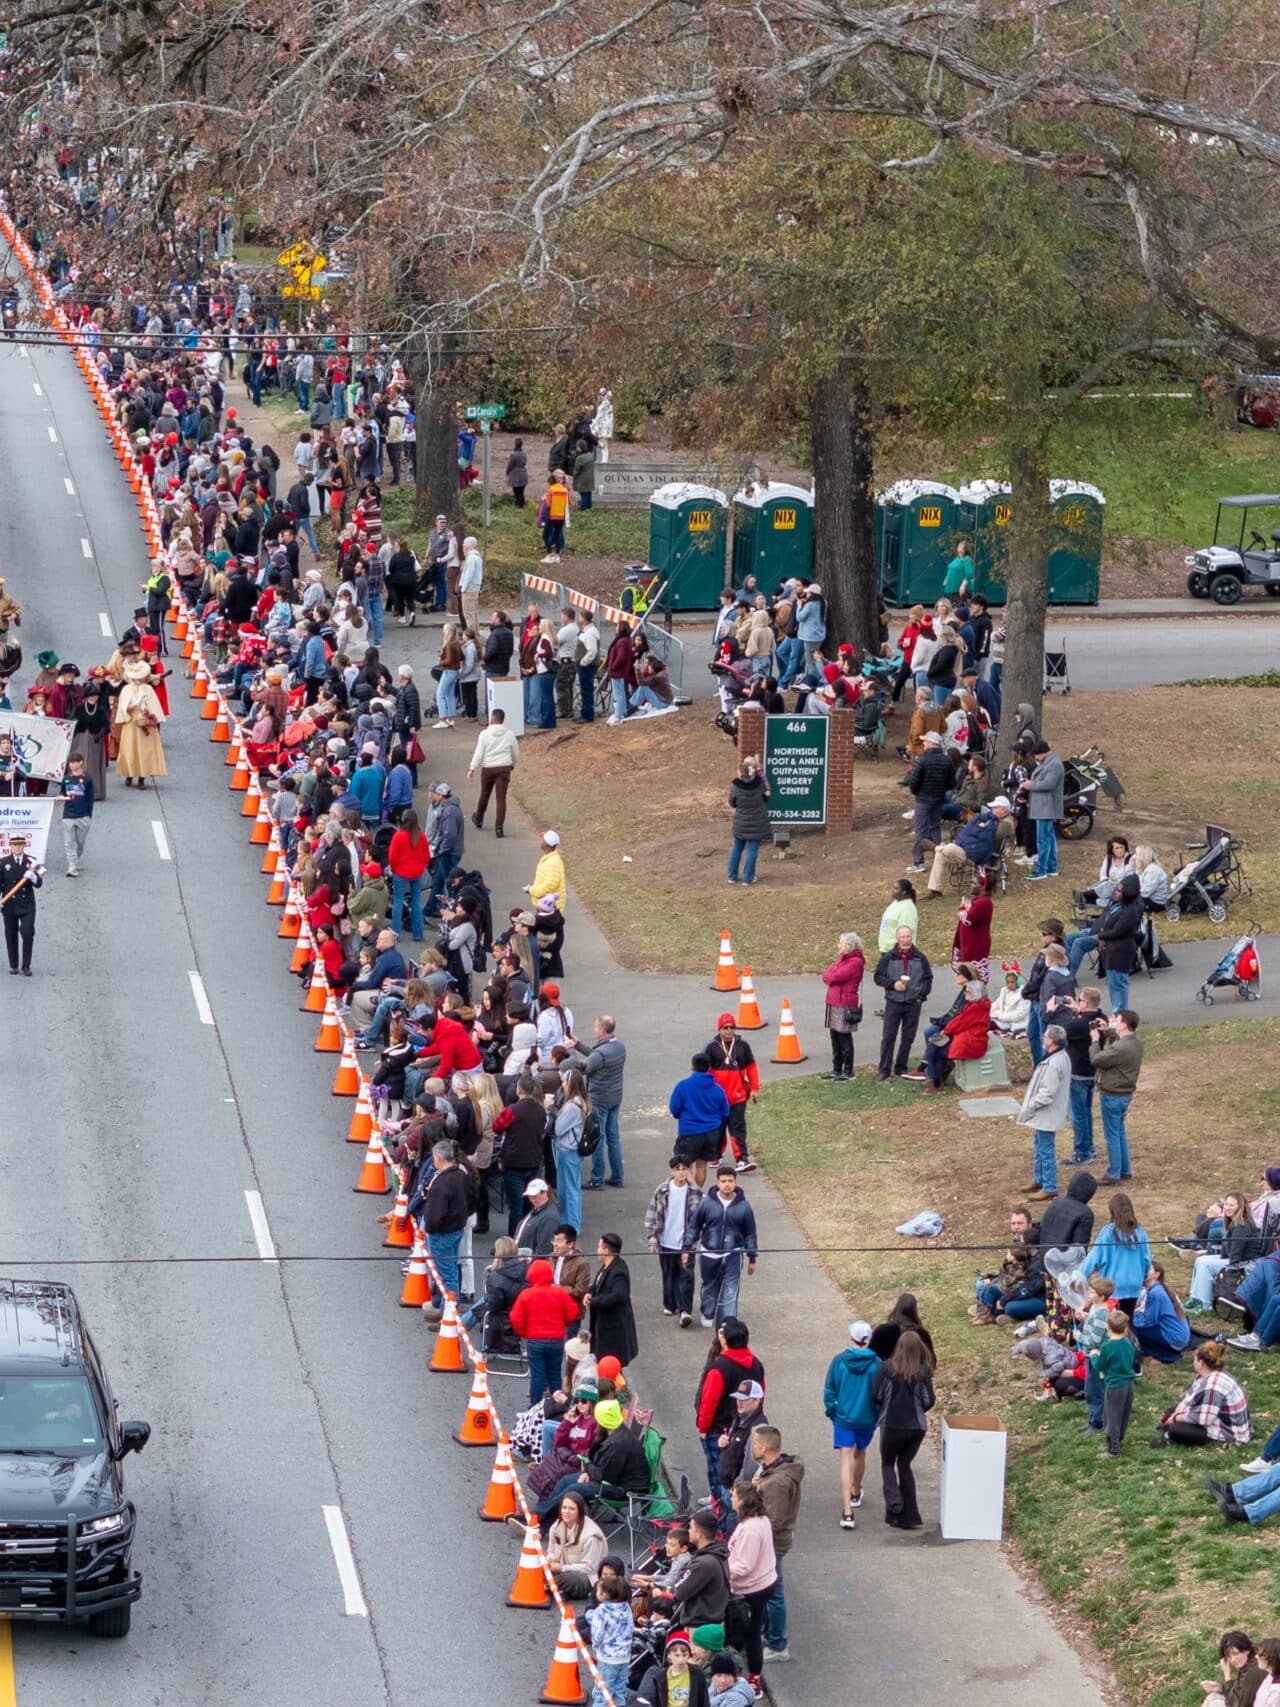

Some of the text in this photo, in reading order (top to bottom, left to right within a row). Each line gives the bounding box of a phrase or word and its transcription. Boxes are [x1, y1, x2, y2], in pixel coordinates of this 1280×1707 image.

[604, 475, 645, 483] QUINLAN
[690, 512, 709, 524] NIX
[775, 511, 794, 522] NIX
[920, 509, 939, 521] NIX
[786, 722, 807, 732] 466
[798, 758, 824, 766] ANKLE
[771, 767, 819, 775] OUTPATIENT
[776, 777, 813, 785] SURGERY
[779, 787, 810, 795] CENTER
